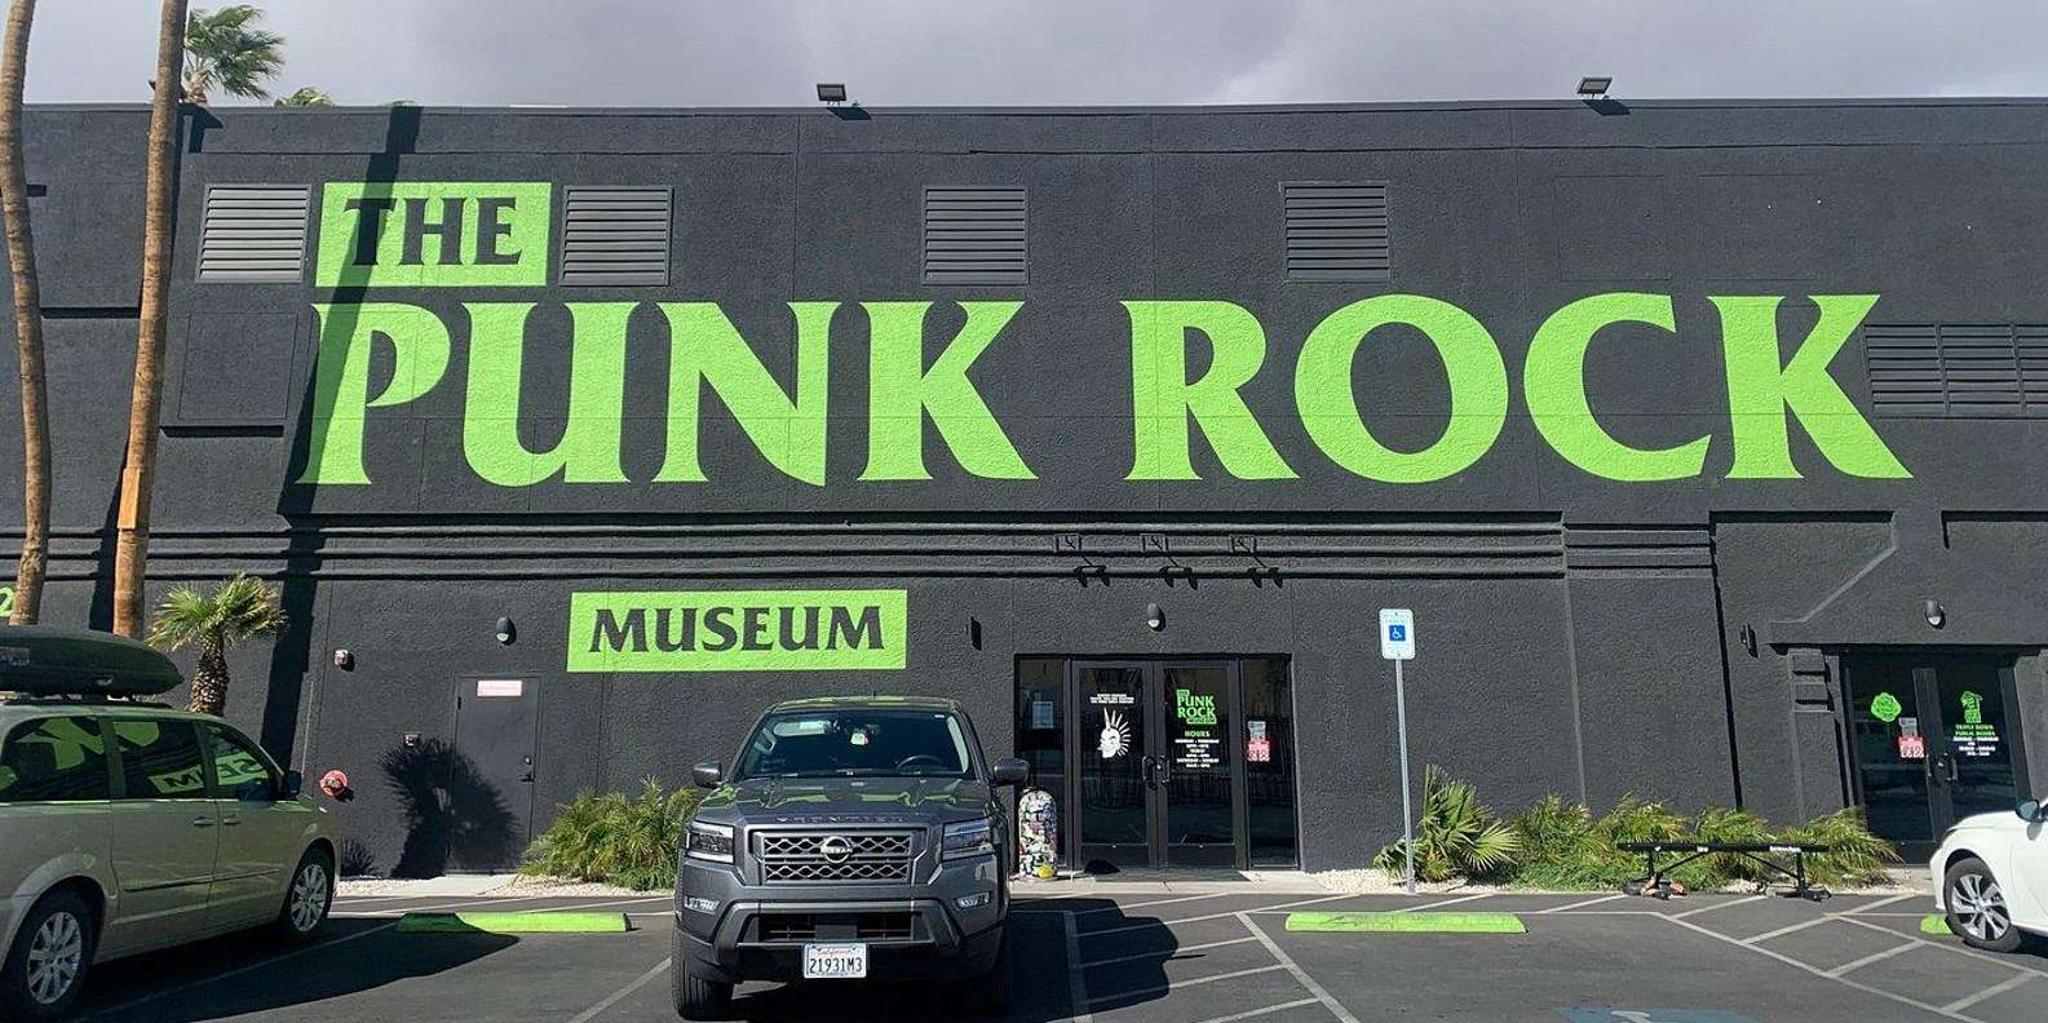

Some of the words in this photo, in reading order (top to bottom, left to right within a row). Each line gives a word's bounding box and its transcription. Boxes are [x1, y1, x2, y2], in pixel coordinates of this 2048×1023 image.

[344, 196, 523, 267] THE
[297, 300, 1038, 487] PUNK
[1119, 291, 1914, 484] ROCK
[591, 605, 884, 654] MUSEUM
[1177, 695, 1214, 707] PUNK
[1177, 707, 1216, 718] ROCK
[809, 956, 863, 974] 21931M3
